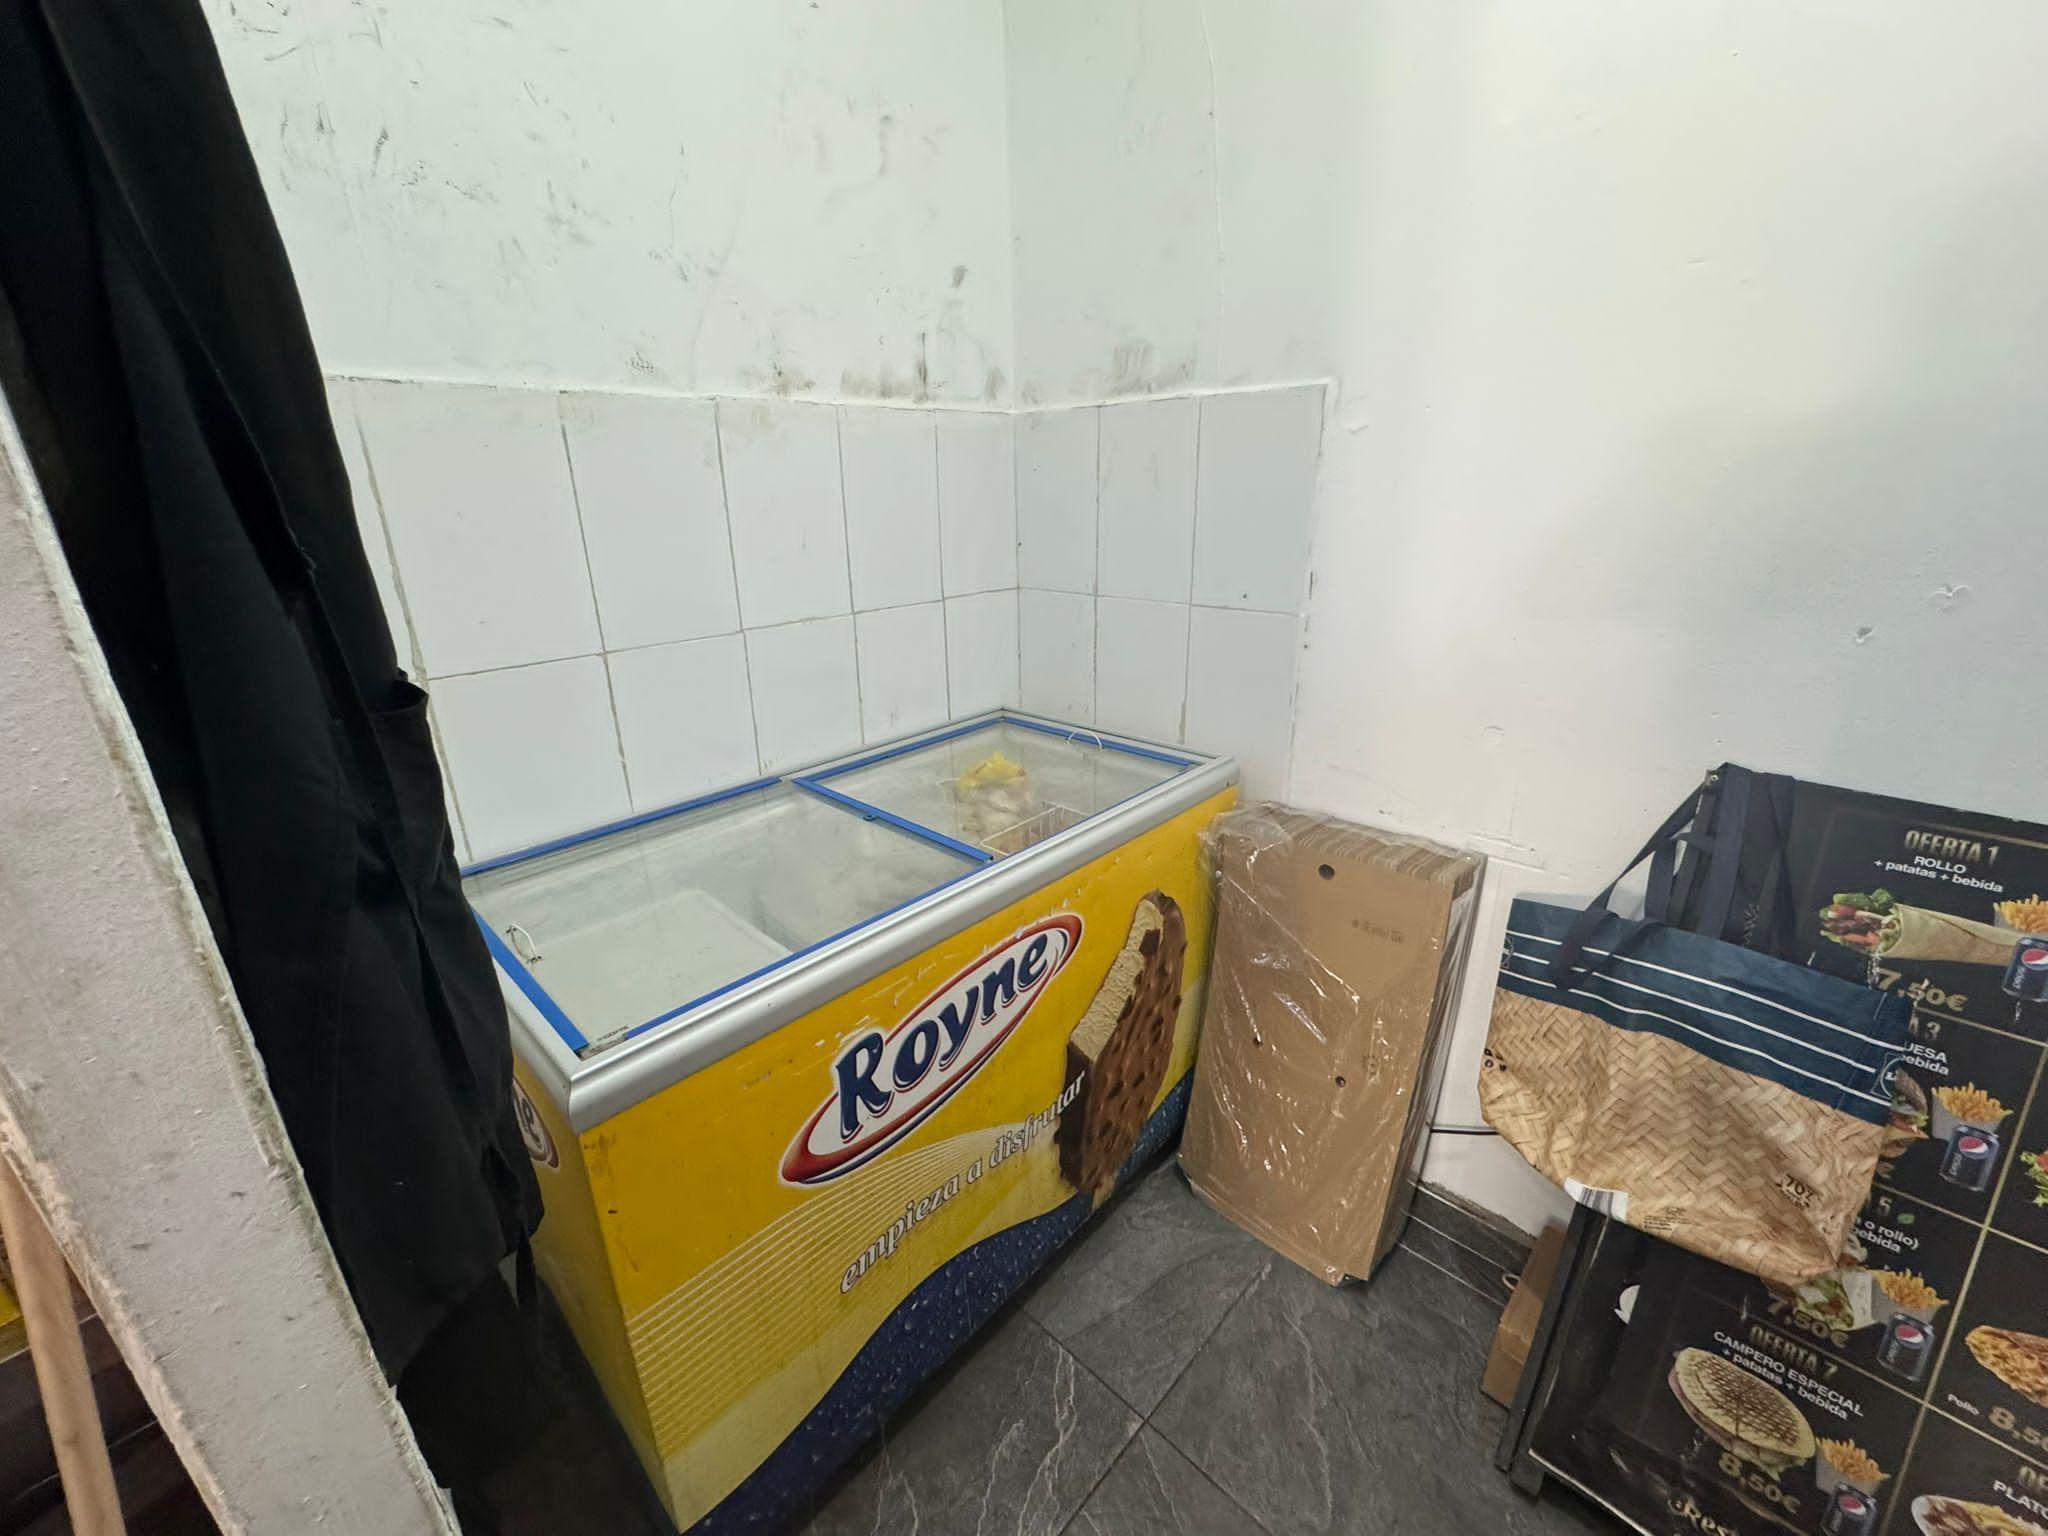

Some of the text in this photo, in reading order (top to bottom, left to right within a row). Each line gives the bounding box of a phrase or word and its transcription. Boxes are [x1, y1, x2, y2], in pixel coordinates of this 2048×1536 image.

[1904, 829, 2000, 867] OFERTA 1
[1913, 855, 1967, 875] ROLLO
[1885, 860, 1937, 881] patatas
[1952, 873, 2003, 893] bebida
[832, 931, 1049, 1144] Royne
[839, 1071, 1086, 1295] empieza a disfrutar
[1878, 1225, 1918, 1251] rollo)
[1713, 1330, 1864, 1417] CAMPERO ESPECIAL
[1733, 1353, 1784, 1386] patatas
[1797, 1385, 1849, 1421] bebida
